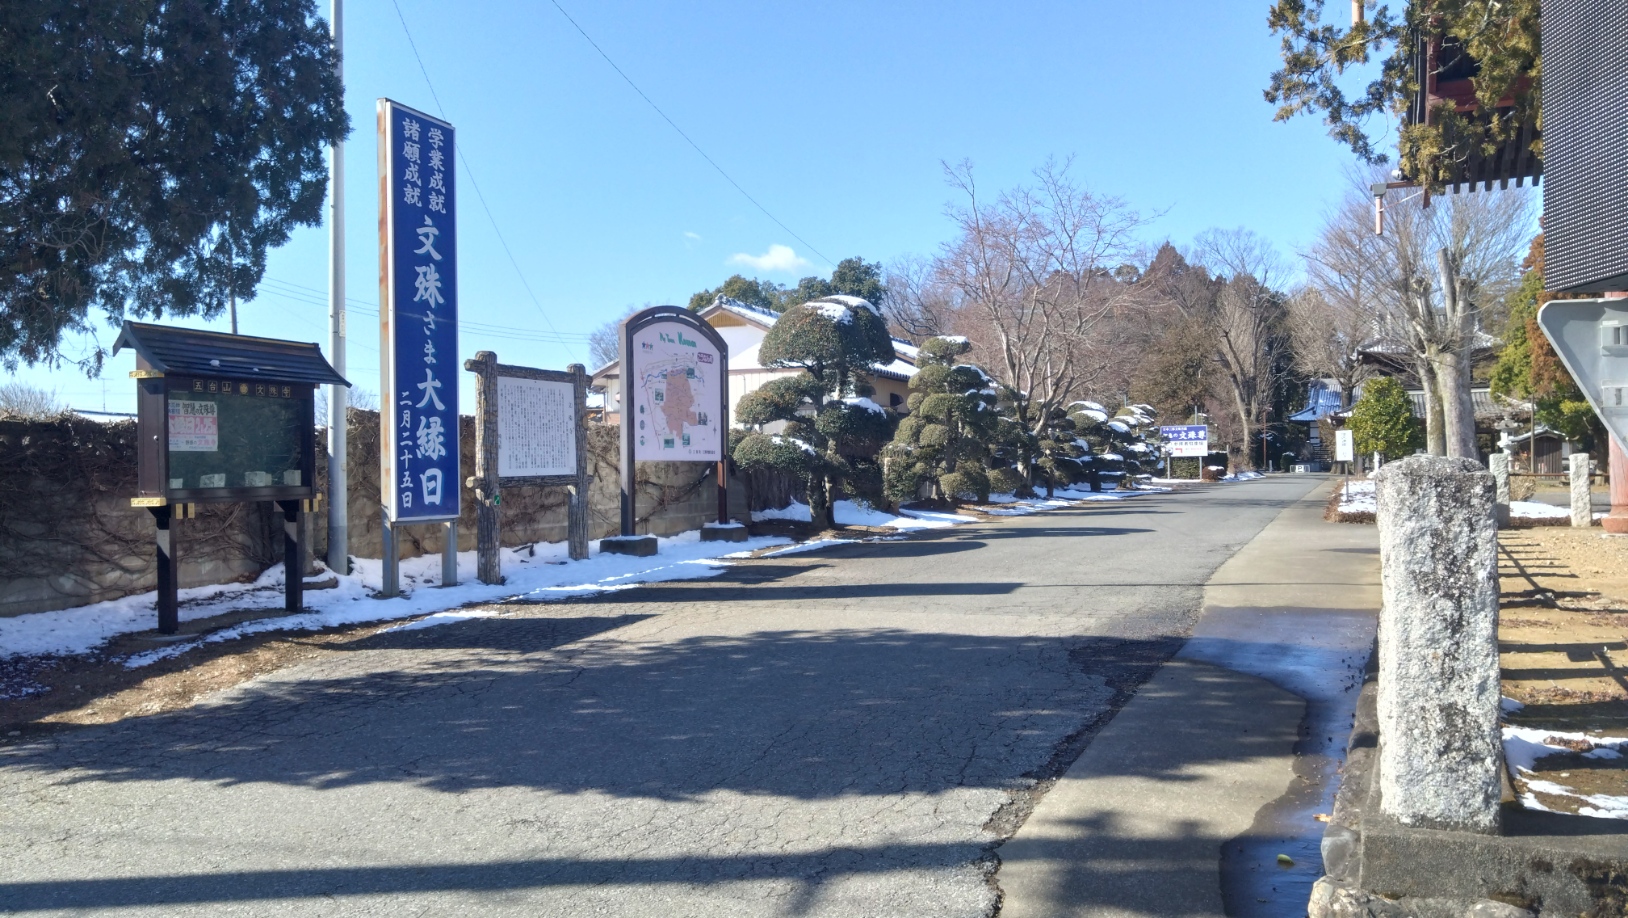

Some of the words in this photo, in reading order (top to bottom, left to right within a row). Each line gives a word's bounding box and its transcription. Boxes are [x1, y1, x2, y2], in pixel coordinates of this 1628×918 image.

[402, 117, 422, 208] 諸願成就
[428, 127, 446, 214] 学業成就
[194, 381, 231, 394] 五台山
[413, 215, 446, 505] 文殊さま大縁日
[400, 391, 414, 509] 二月二十五日
